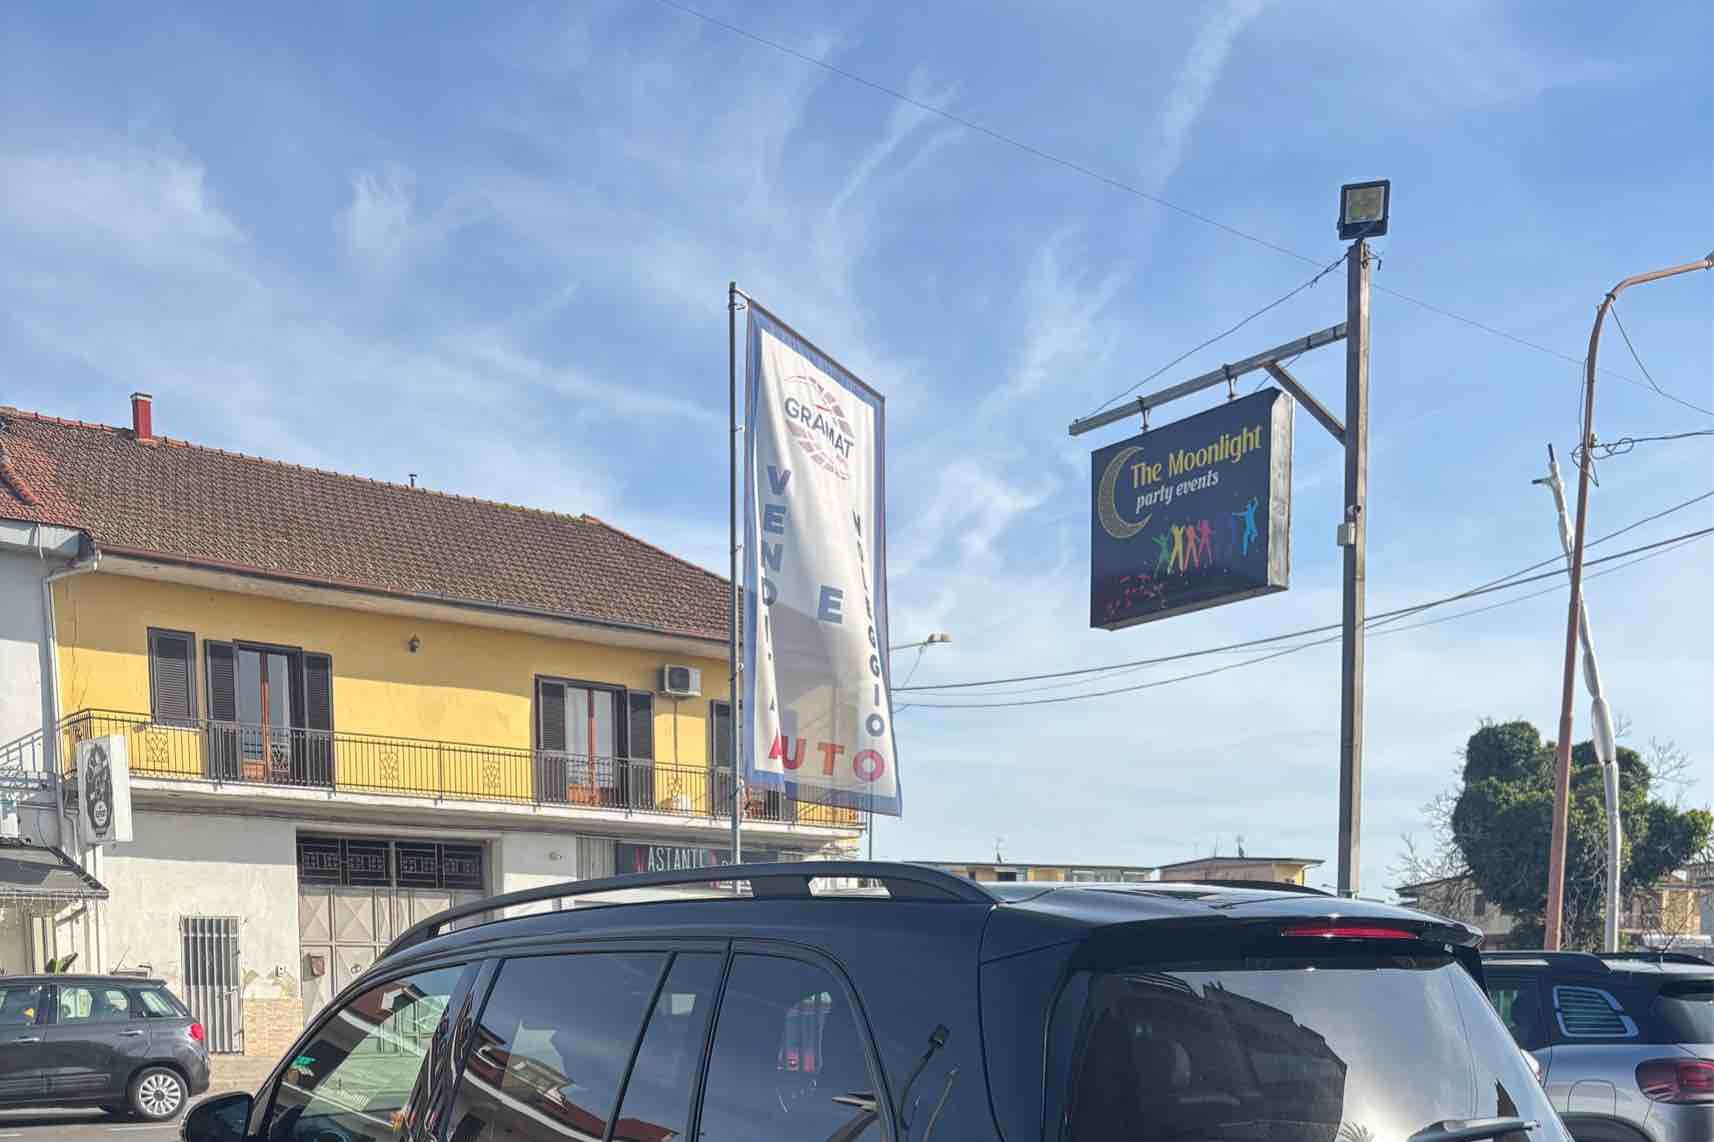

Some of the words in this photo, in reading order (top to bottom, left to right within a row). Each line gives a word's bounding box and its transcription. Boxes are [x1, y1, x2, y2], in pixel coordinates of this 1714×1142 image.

[783, 397, 854, 459] GRAMAT
[1130, 461, 1162, 489] The
[1168, 424, 1263, 478] Moonlight
[1135, 483, 1174, 515] party
[1175, 469, 1219, 497] events
[761, 464, 792, 712] VENDIA
[817, 584, 844, 625] E
[768, 728, 885, 783] AUTO
